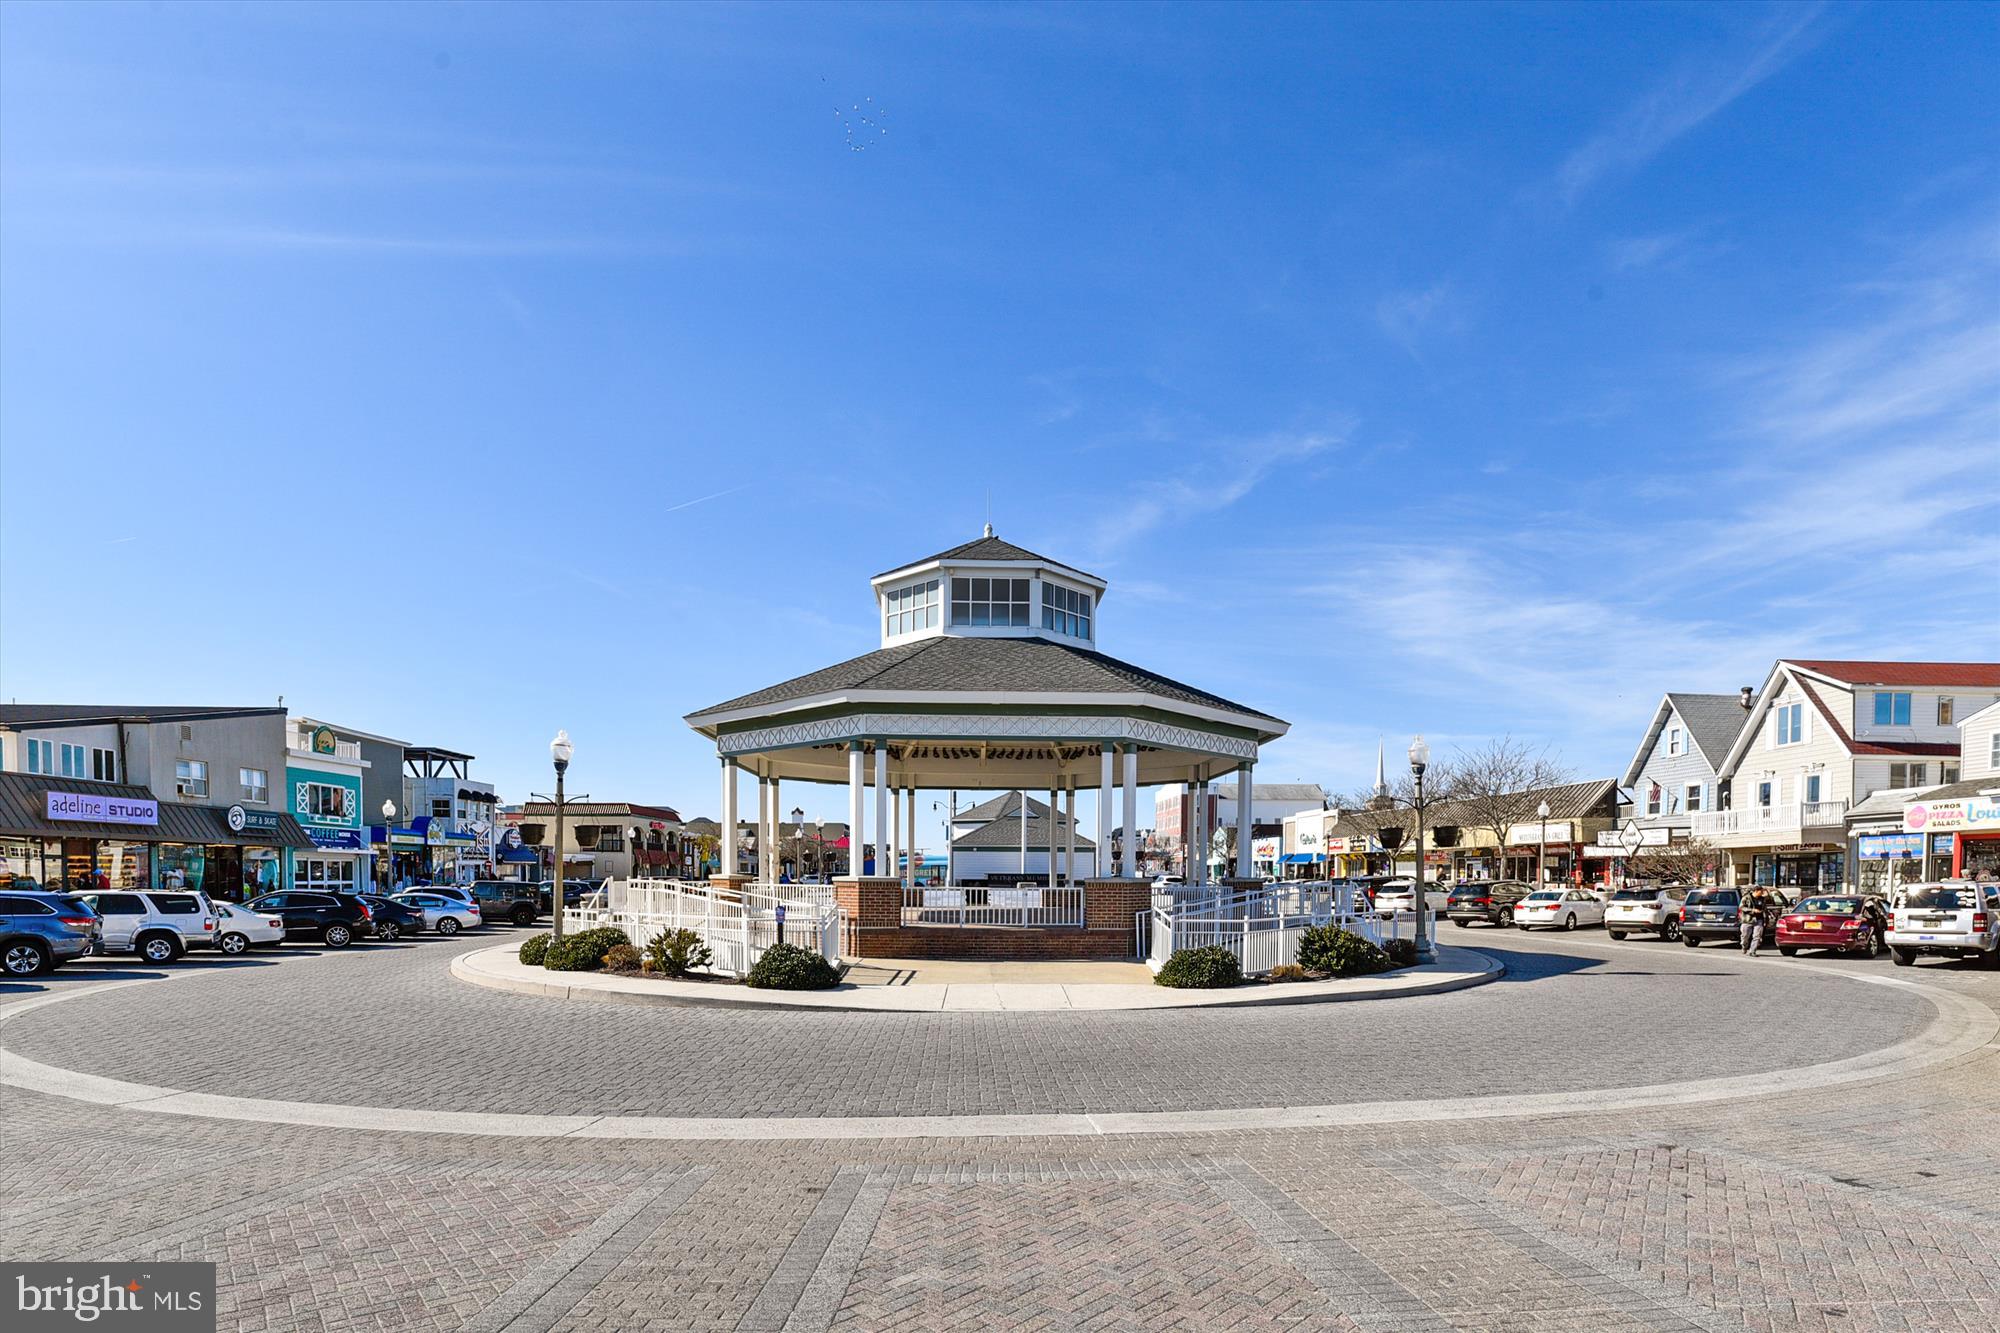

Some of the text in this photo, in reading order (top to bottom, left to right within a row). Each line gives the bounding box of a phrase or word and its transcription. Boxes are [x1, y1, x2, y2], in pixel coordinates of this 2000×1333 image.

[52, 795, 101, 814] adeline
[109, 805, 154, 818] STUDIO
[1928, 811, 1965, 820] PIZZA
[311, 828, 339, 839] COFFEE
